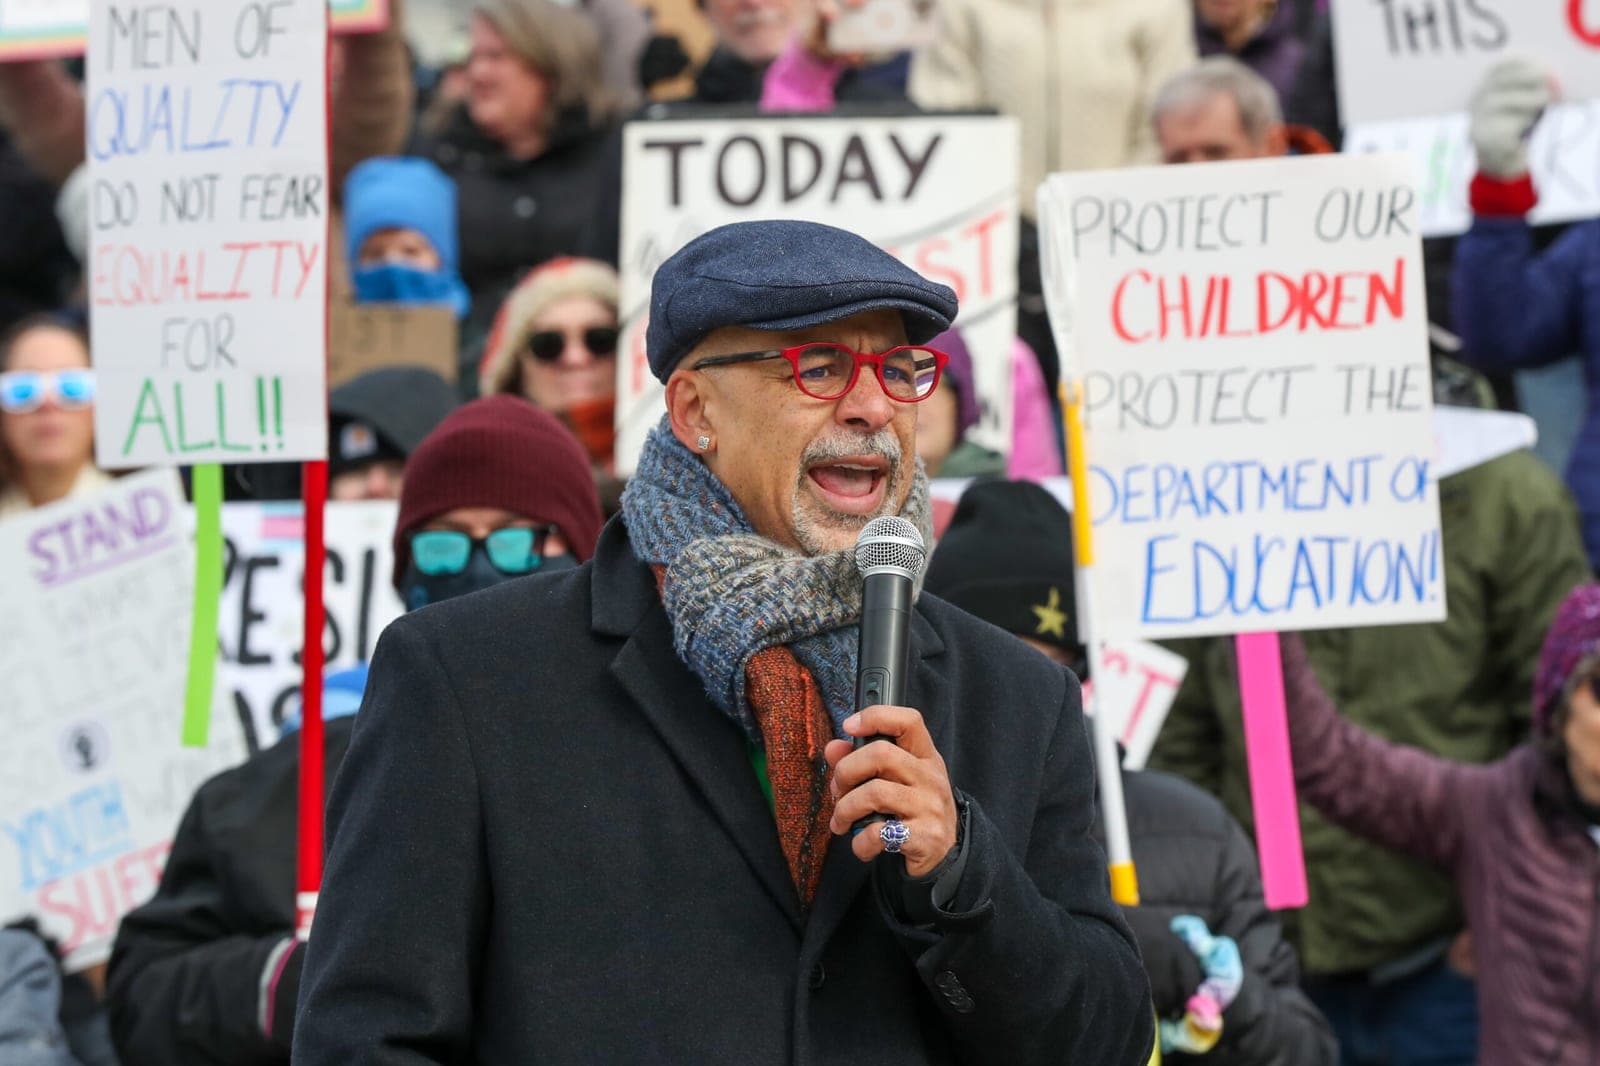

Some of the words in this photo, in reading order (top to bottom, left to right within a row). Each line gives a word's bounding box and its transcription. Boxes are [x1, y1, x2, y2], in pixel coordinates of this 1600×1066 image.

[106, 5, 201, 71] MEN
[233, 1, 292, 60] OF
[1378, 0, 1508, 57] THIS
[89, 79, 301, 160] QUALITY
[94, 181, 136, 229] DO
[161, 174, 220, 222] NOT
[240, 174, 323, 221] FEAR
[643, 133, 943, 207] TODAY
[1071, 190, 1283, 259] PROTECT
[1315, 185, 1414, 243] OUR
[94, 241, 319, 306] EQUALITY
[1110, 257, 1405, 343] CHILDREN
[160, 314, 237, 371] FOR
[123, 376, 283, 456] ALL!!
[1083, 364, 1317, 432] PROTECT
[1336, 363, 1425, 415] THE
[1087, 455, 1383, 527] DEPARTMENT
[27, 486, 171, 582] STAND
[1141, 530, 1438, 624] EDUCATION!
